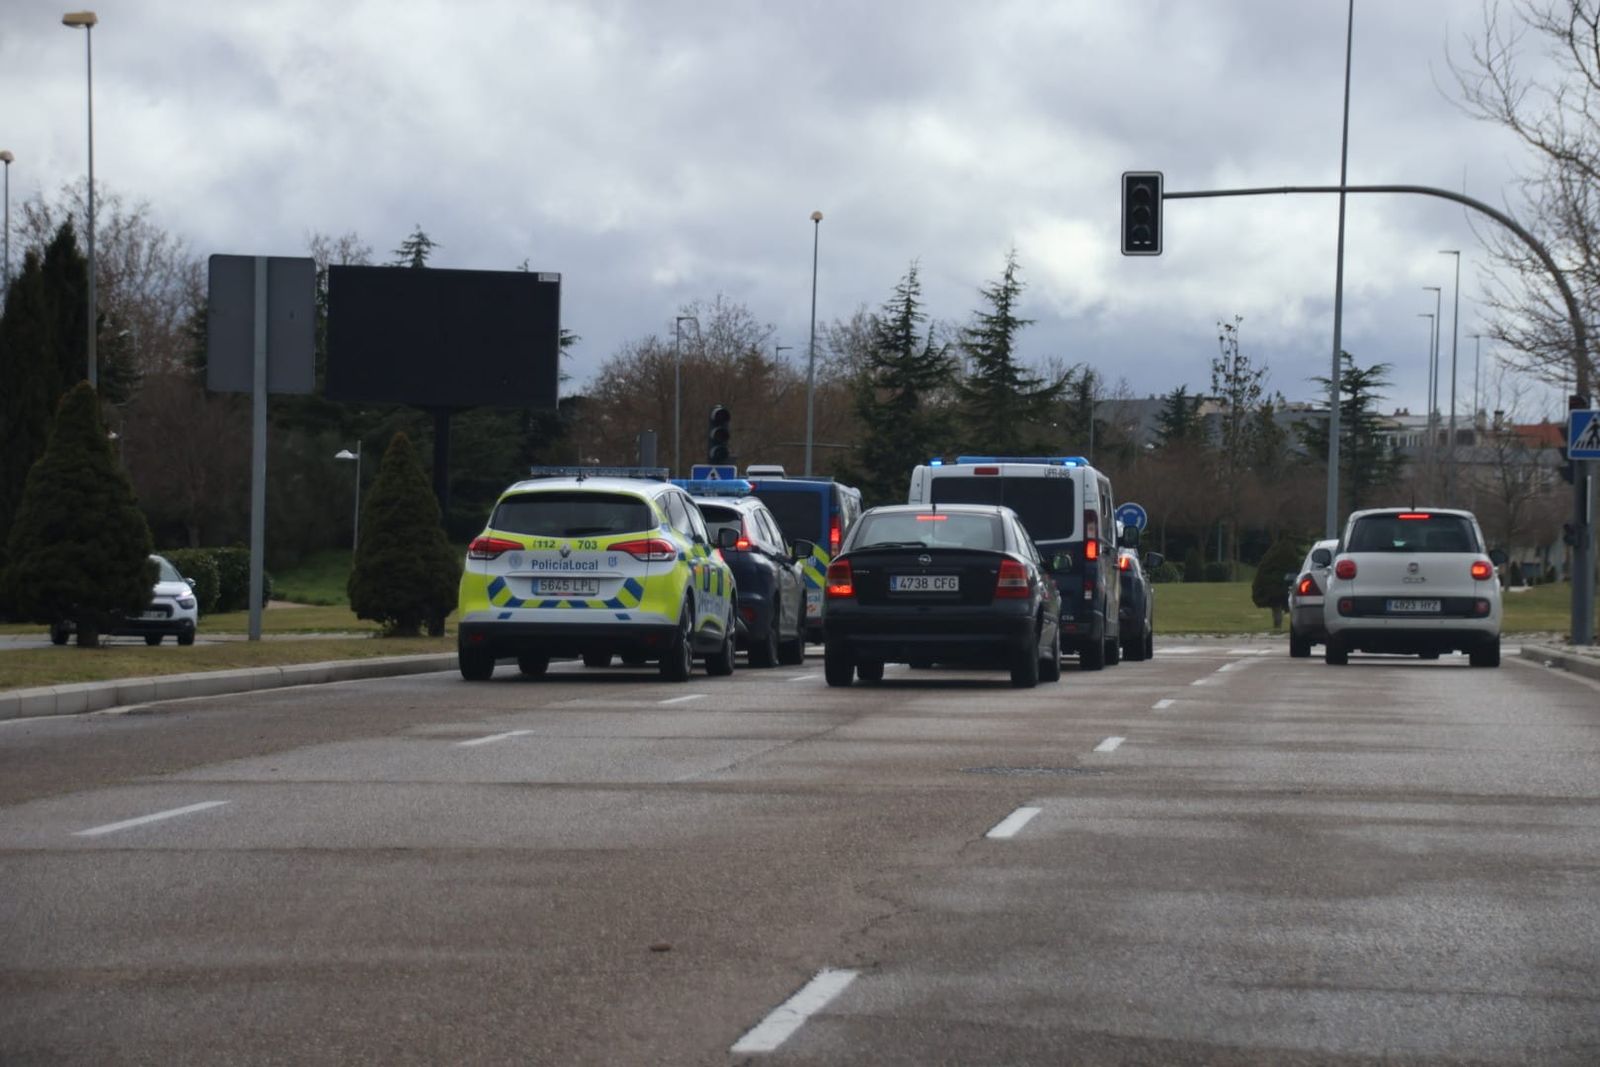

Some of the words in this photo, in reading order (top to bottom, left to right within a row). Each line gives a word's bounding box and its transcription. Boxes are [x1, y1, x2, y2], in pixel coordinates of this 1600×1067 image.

[537, 540, 556, 549] 112
[577, 540, 598, 550] 703
[573, 579, 595, 592] LPL
[900, 577, 929, 589] 4738
[934, 577, 957, 589] CFG
